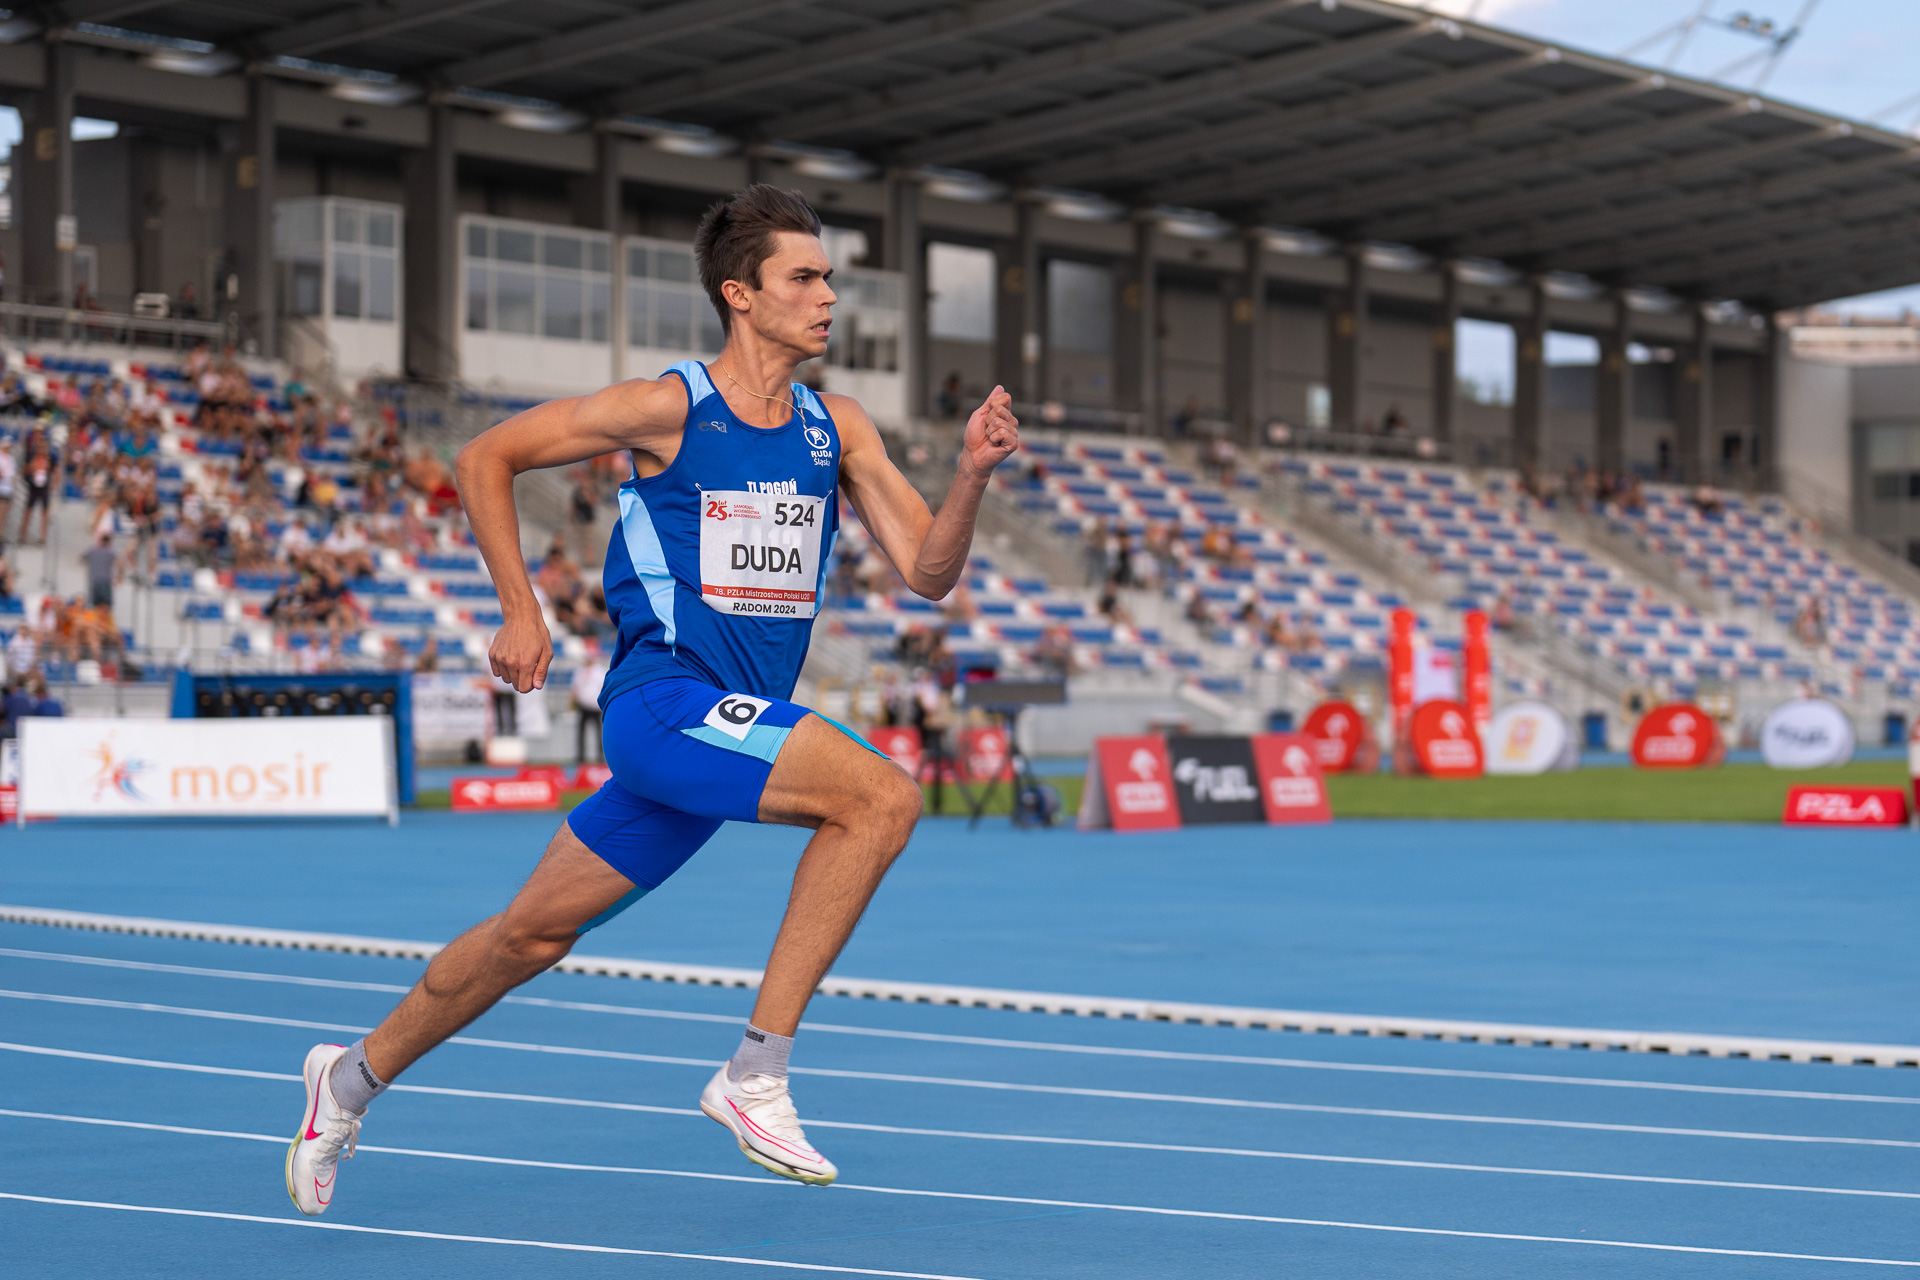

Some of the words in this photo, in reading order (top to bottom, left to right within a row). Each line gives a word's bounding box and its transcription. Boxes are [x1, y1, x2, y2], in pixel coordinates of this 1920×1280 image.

[811, 450, 833, 459] RUDA
[759, 478, 797, 495] POGOŃ
[774, 502, 815, 528] 524
[731, 543, 803, 574] DUDA
[714, 587, 726, 596] 78.
[727, 588, 745, 597] PZLA
[745, 589, 783, 599] Mistrzostwa
[784, 592, 800, 600] Polski
[733, 602, 772, 614] RADOM
[774, 604, 796, 615] 2024
[718, 698, 757, 725] 6
[170, 751, 331, 802] mosir
[1796, 793, 1886, 821] PZLA
[358, 1061, 378, 1090] PUMA
